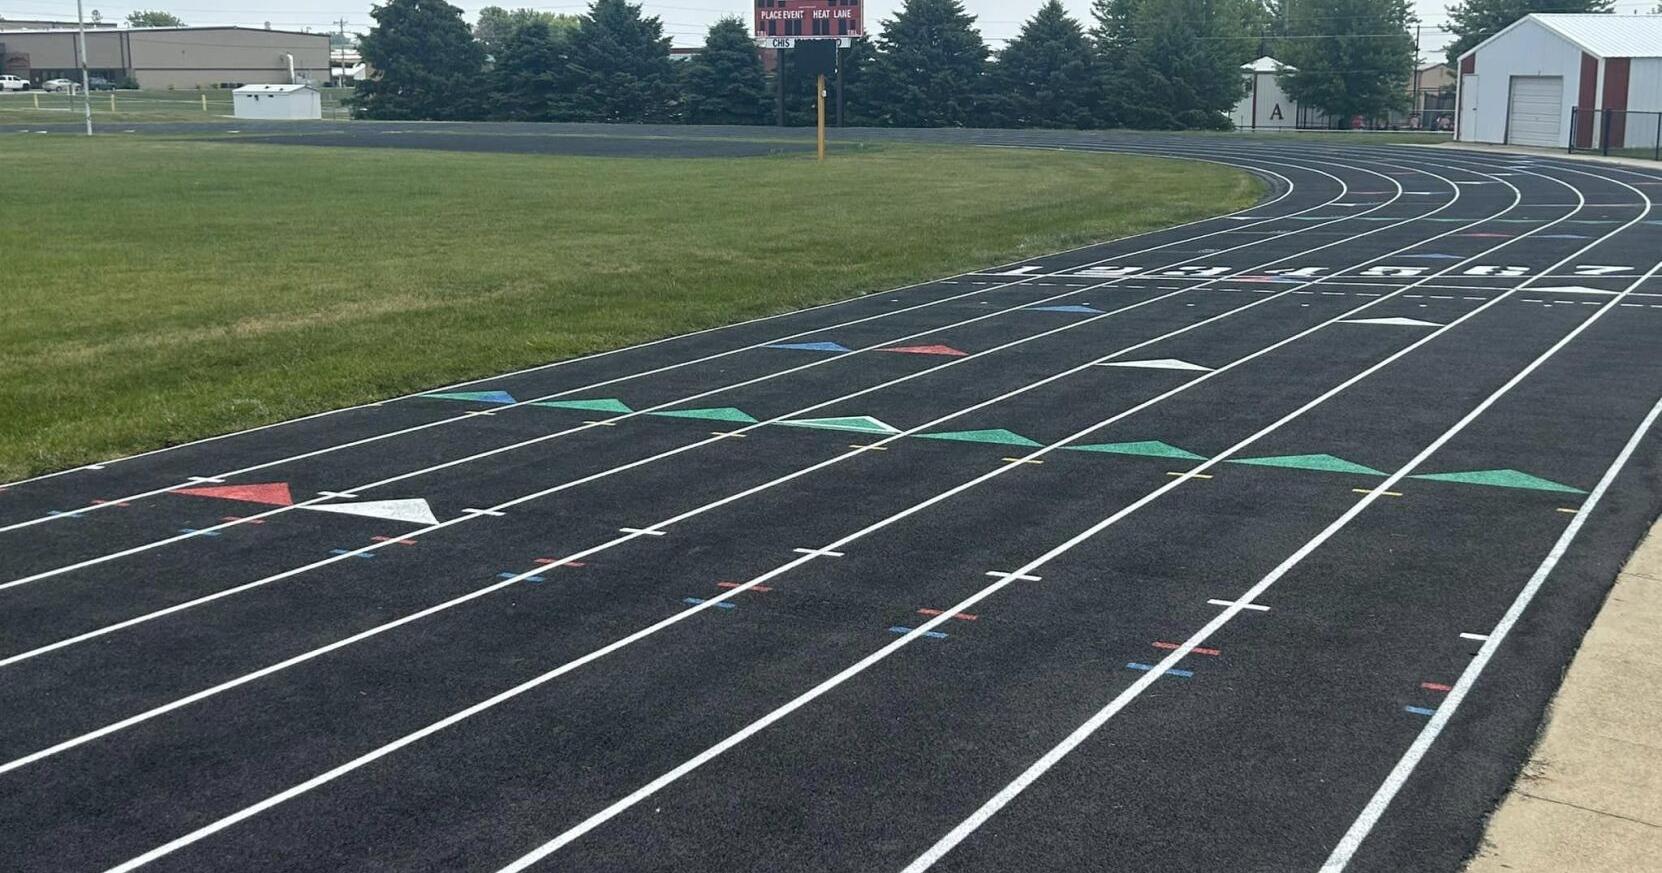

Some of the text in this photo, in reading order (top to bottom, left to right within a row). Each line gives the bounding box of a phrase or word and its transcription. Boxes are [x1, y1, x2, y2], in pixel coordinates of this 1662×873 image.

[761, 9, 852, 19] PLACE EVENT HEAT LANE
[773, 38, 790, 48] CHIS
[1270, 103, 1284, 120] A
[995, 265, 1635, 278] 1 2 3 4 5 6 7
